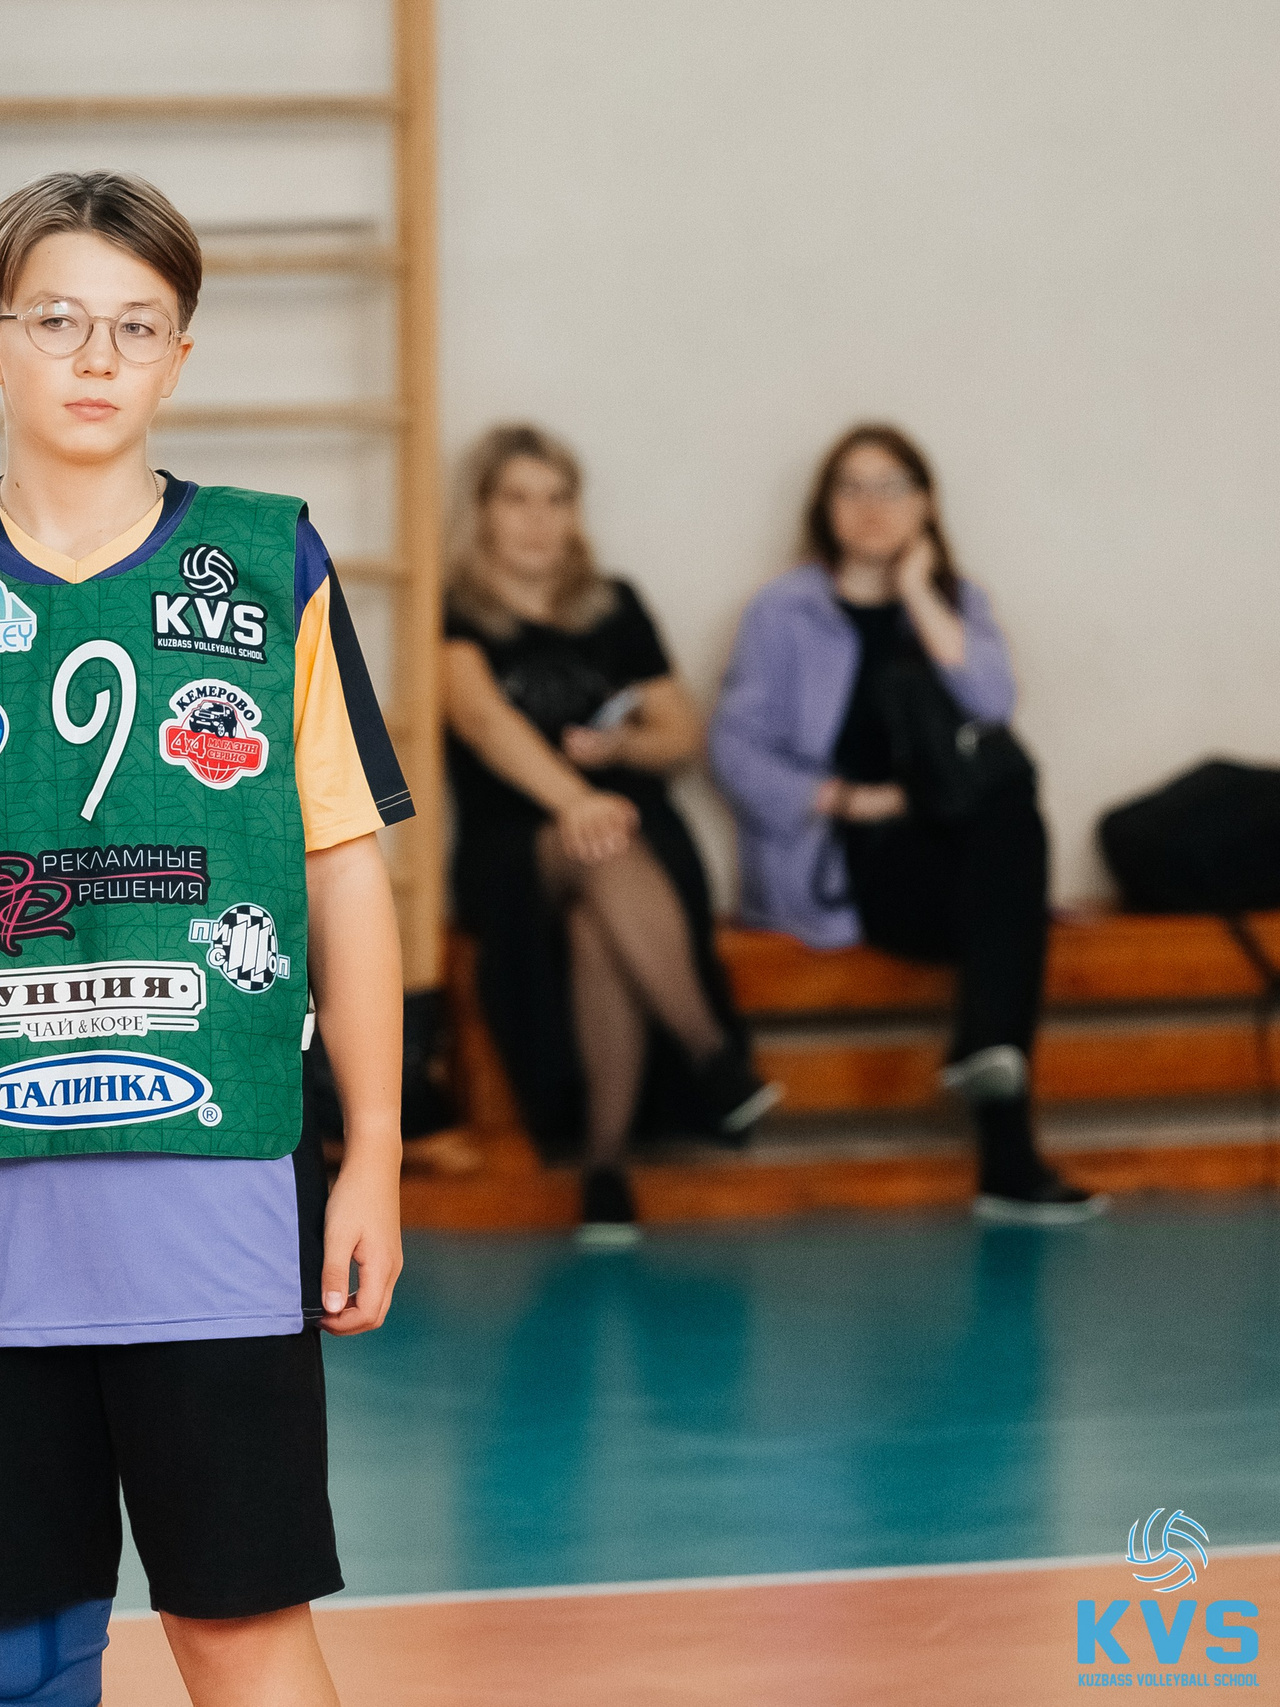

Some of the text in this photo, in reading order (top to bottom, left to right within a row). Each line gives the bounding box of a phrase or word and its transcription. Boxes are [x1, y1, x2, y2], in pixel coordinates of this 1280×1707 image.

[156, 595, 264, 646] KVS
[157, 638, 264, 661] KUZBASS VOLLEYBALL SCHOOL
[176, 685, 255, 721] КЕМЕРОВО
[52, 640, 136, 821] 9
[207, 738, 258, 754] МАГАЗИН
[207, 749, 247, 763] СЕРВИС
[43, 849, 202, 873] РЕКЛАМНЫЕ
[78, 880, 203, 901] РЕШЕНИЯ
[26, 1018, 74, 1037] ЧАЙ
[90, 1014, 144, 1032] КОФЕ
